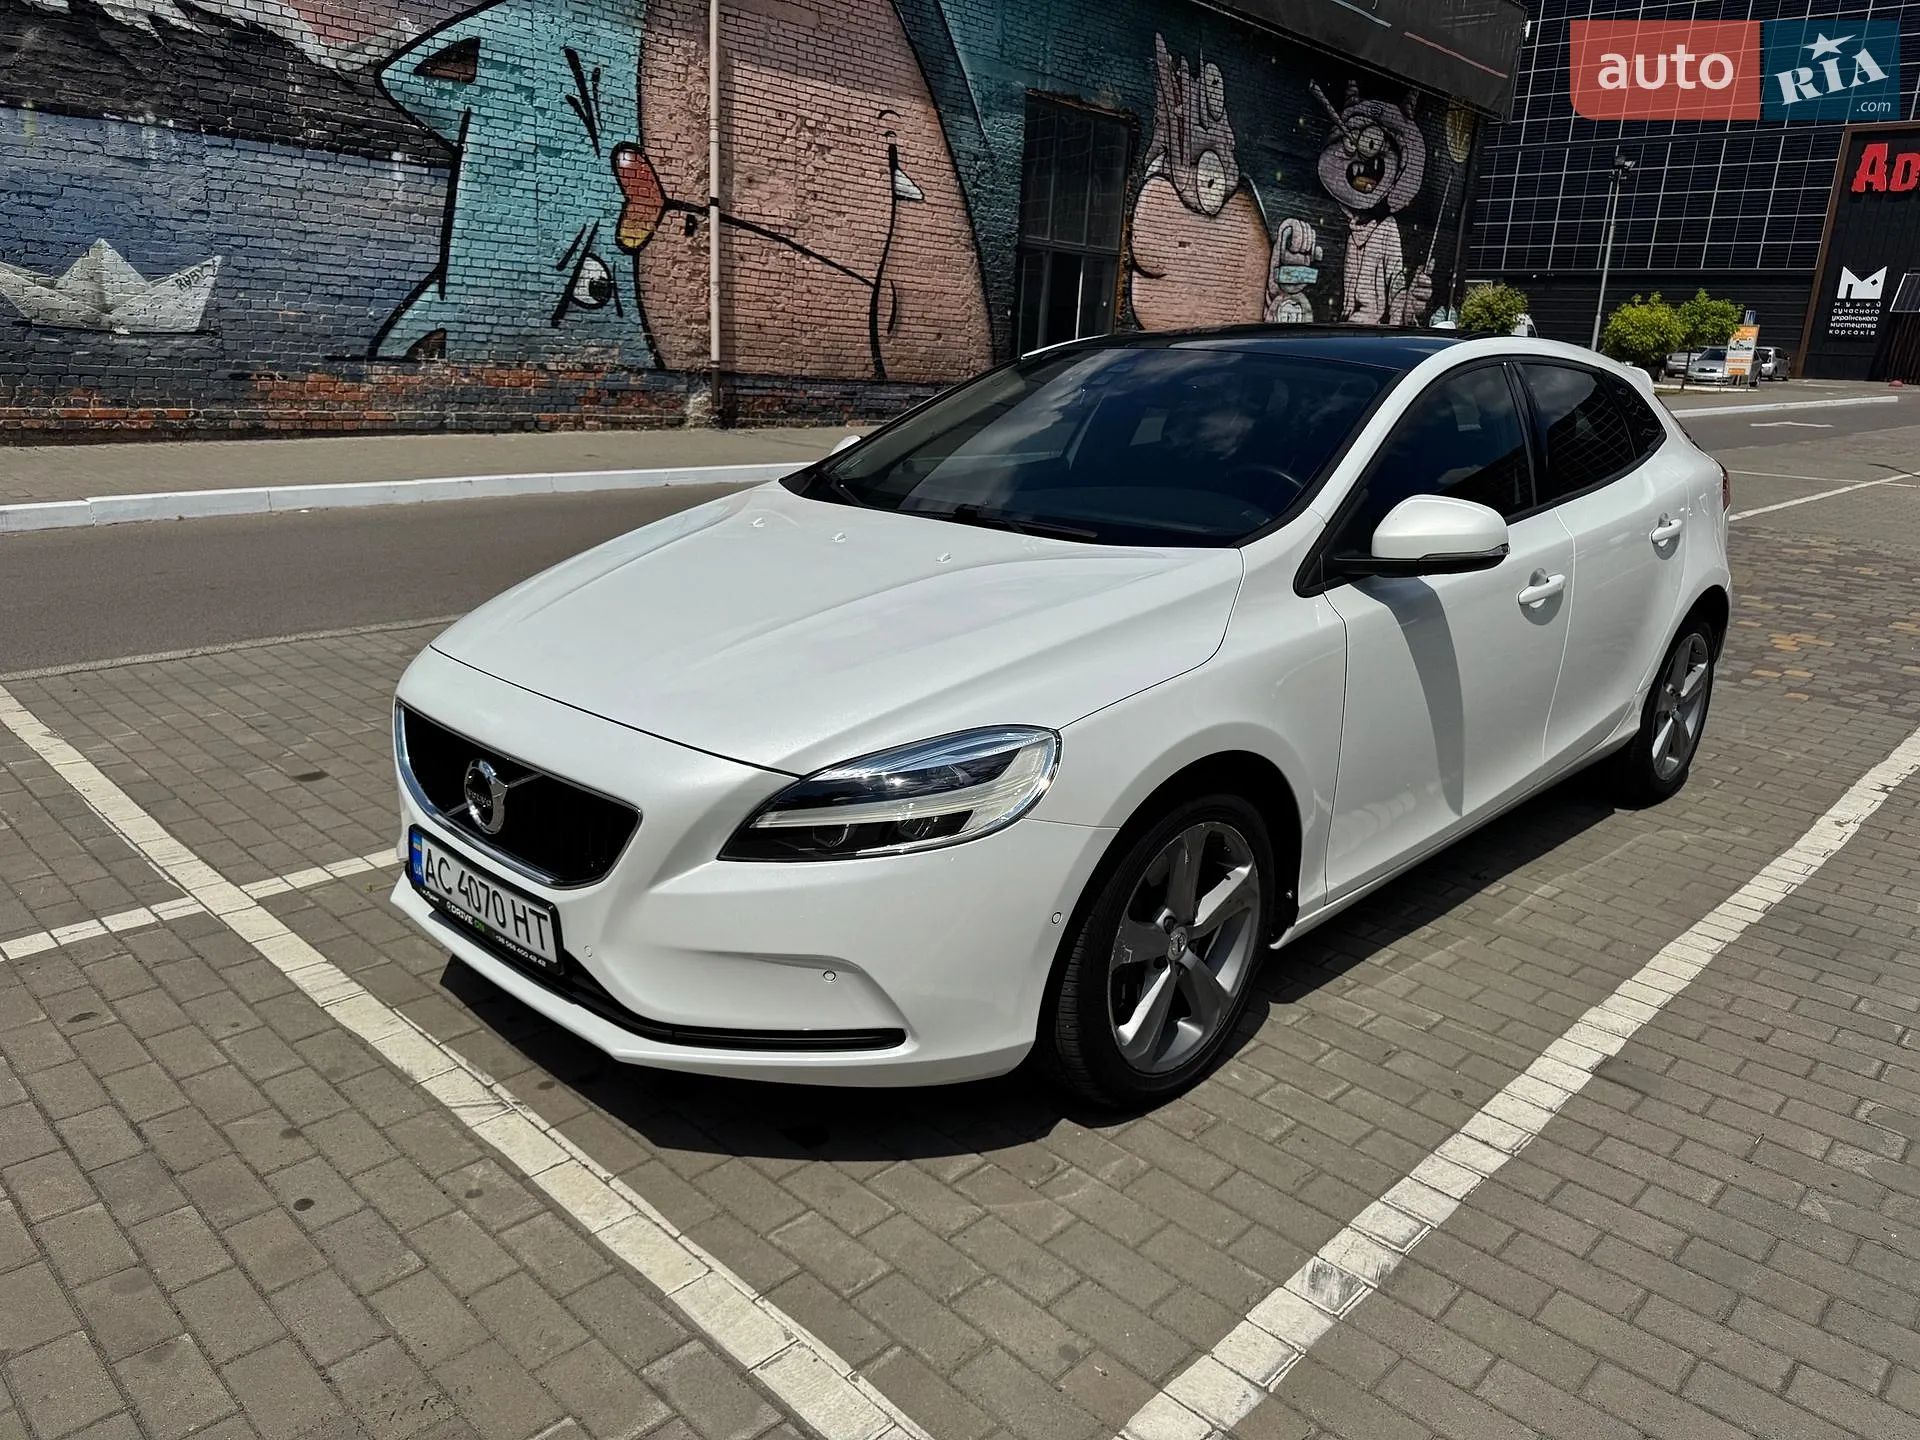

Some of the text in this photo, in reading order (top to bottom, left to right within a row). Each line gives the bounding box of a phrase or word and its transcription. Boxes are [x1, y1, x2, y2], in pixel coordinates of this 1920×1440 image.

[425, 848, 453, 895] AC
[458, 869, 506, 929] 4070
[510, 898, 548, 951] HT
